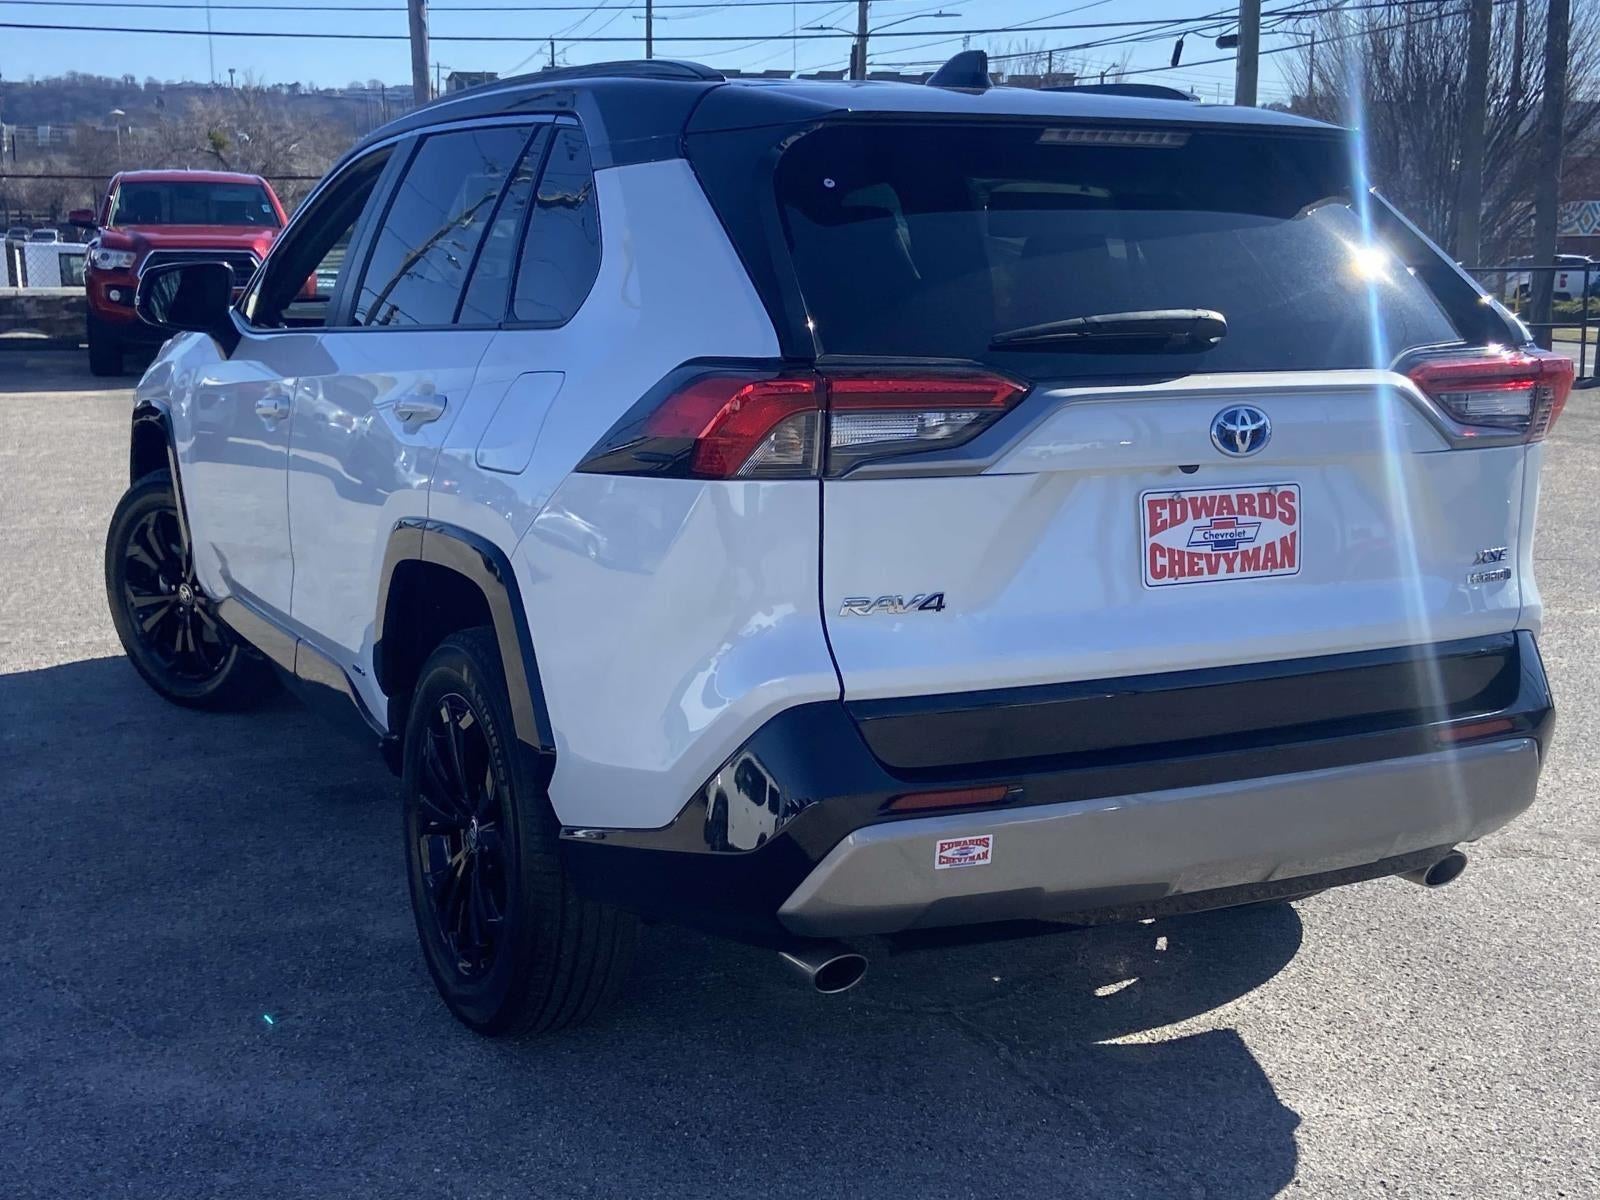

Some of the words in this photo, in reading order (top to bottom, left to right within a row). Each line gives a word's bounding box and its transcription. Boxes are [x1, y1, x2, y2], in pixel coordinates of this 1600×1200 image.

[1147, 491, 1296, 538] EDWARDS
[1202, 528, 1246, 540] Chevrolet
[1149, 530, 1297, 580] CHEVYMAN
[839, 592, 945, 616] RAV4
